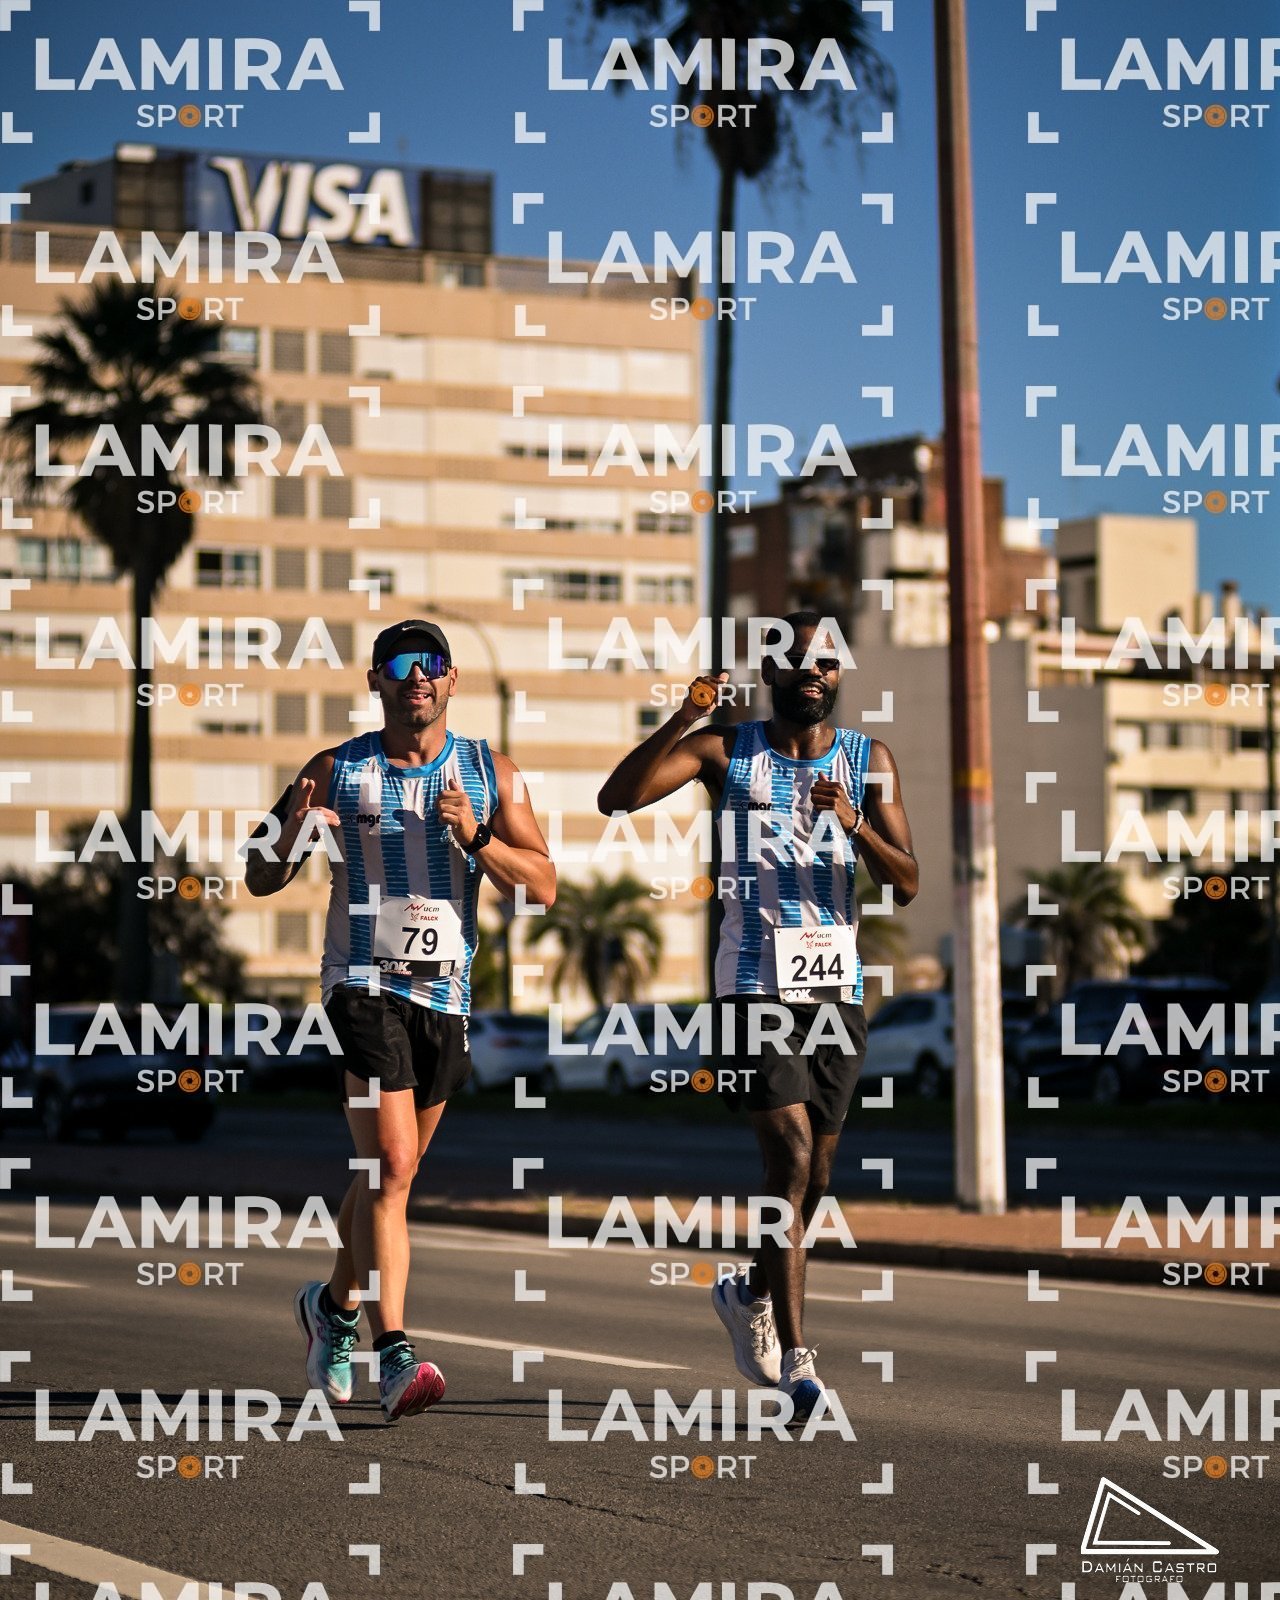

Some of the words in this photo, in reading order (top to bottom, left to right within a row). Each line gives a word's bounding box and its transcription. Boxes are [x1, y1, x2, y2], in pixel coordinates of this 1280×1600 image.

[210, 157, 414, 246] VISA
[402, 926, 438, 956] 79
[790, 953, 844, 982] 244
